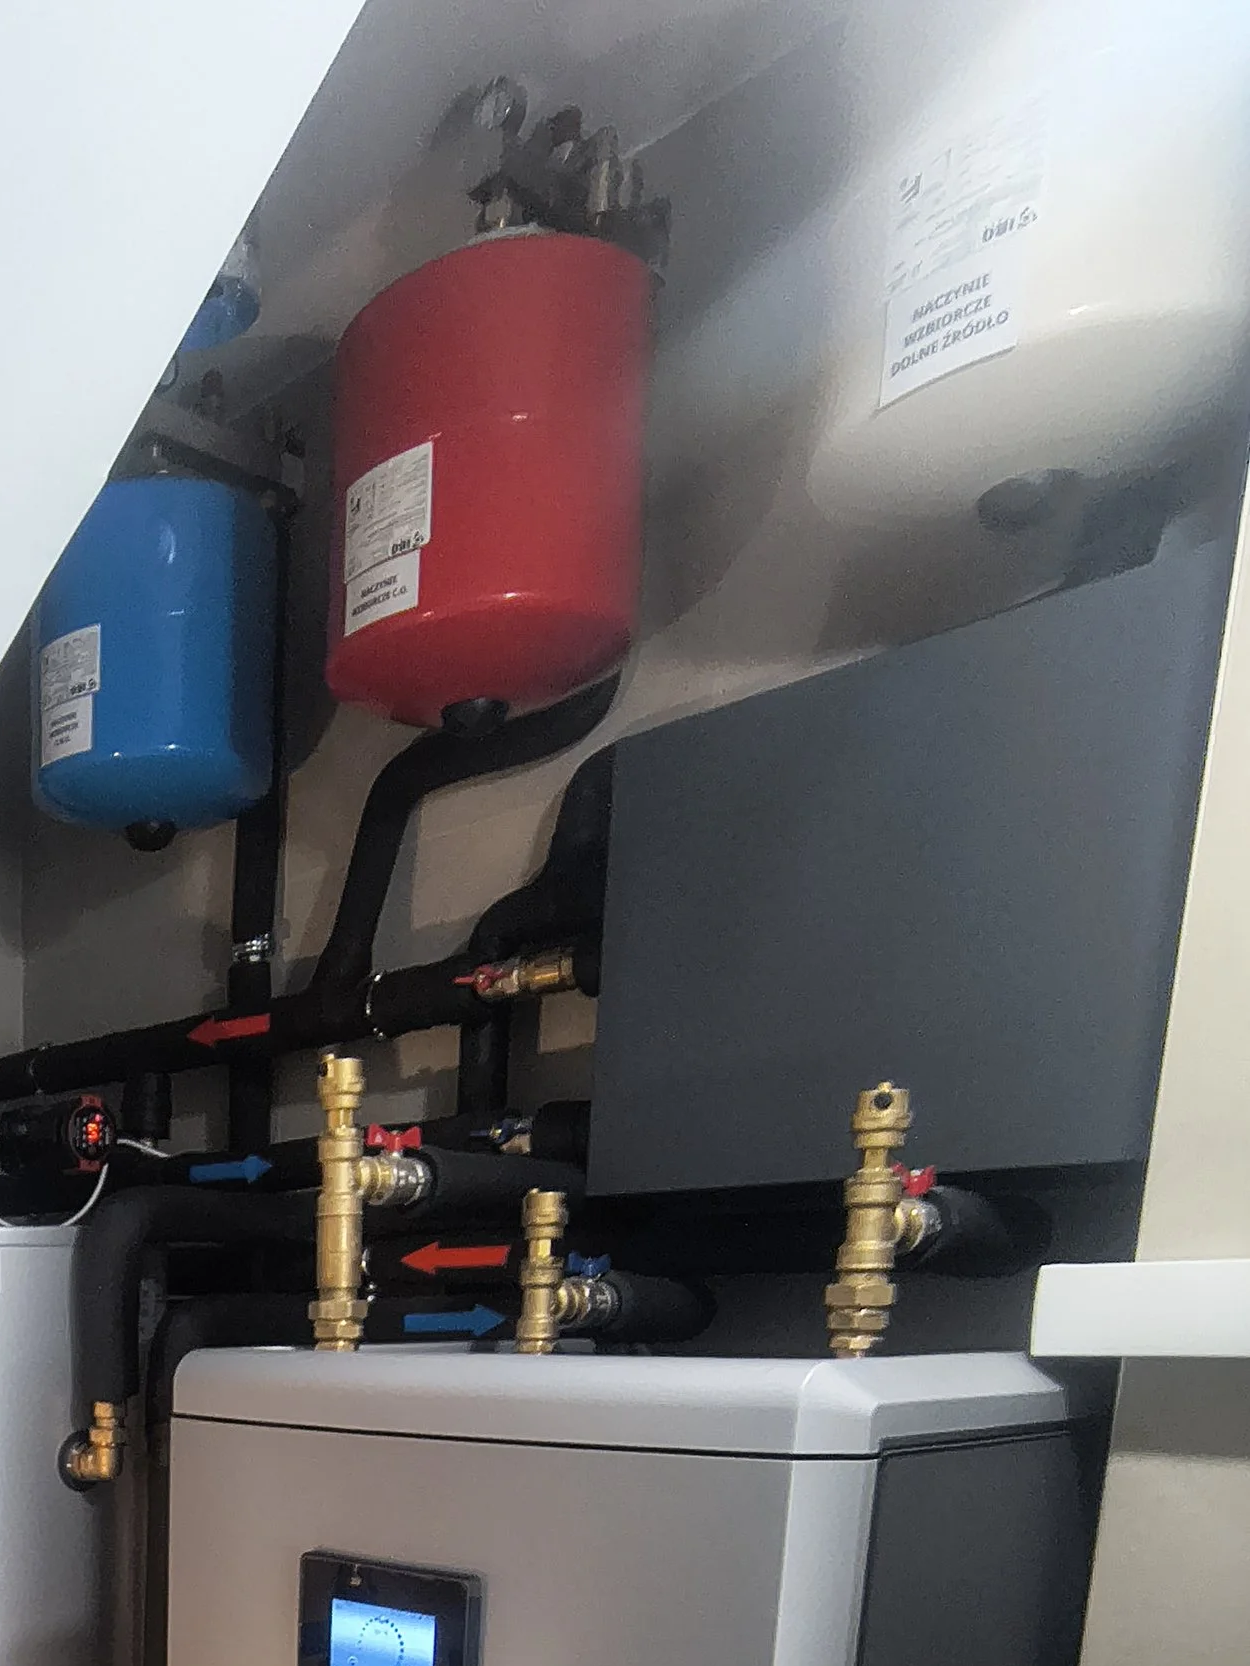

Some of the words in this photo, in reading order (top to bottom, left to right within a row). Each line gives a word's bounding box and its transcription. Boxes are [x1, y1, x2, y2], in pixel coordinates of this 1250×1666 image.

[904, 295, 992, 348] WZBIORCZE
[912, 273, 990, 322] NACZYNIE
[891, 339, 939, 377] DOLNE
[941, 310, 1009, 351] ŹRÓDŁO
